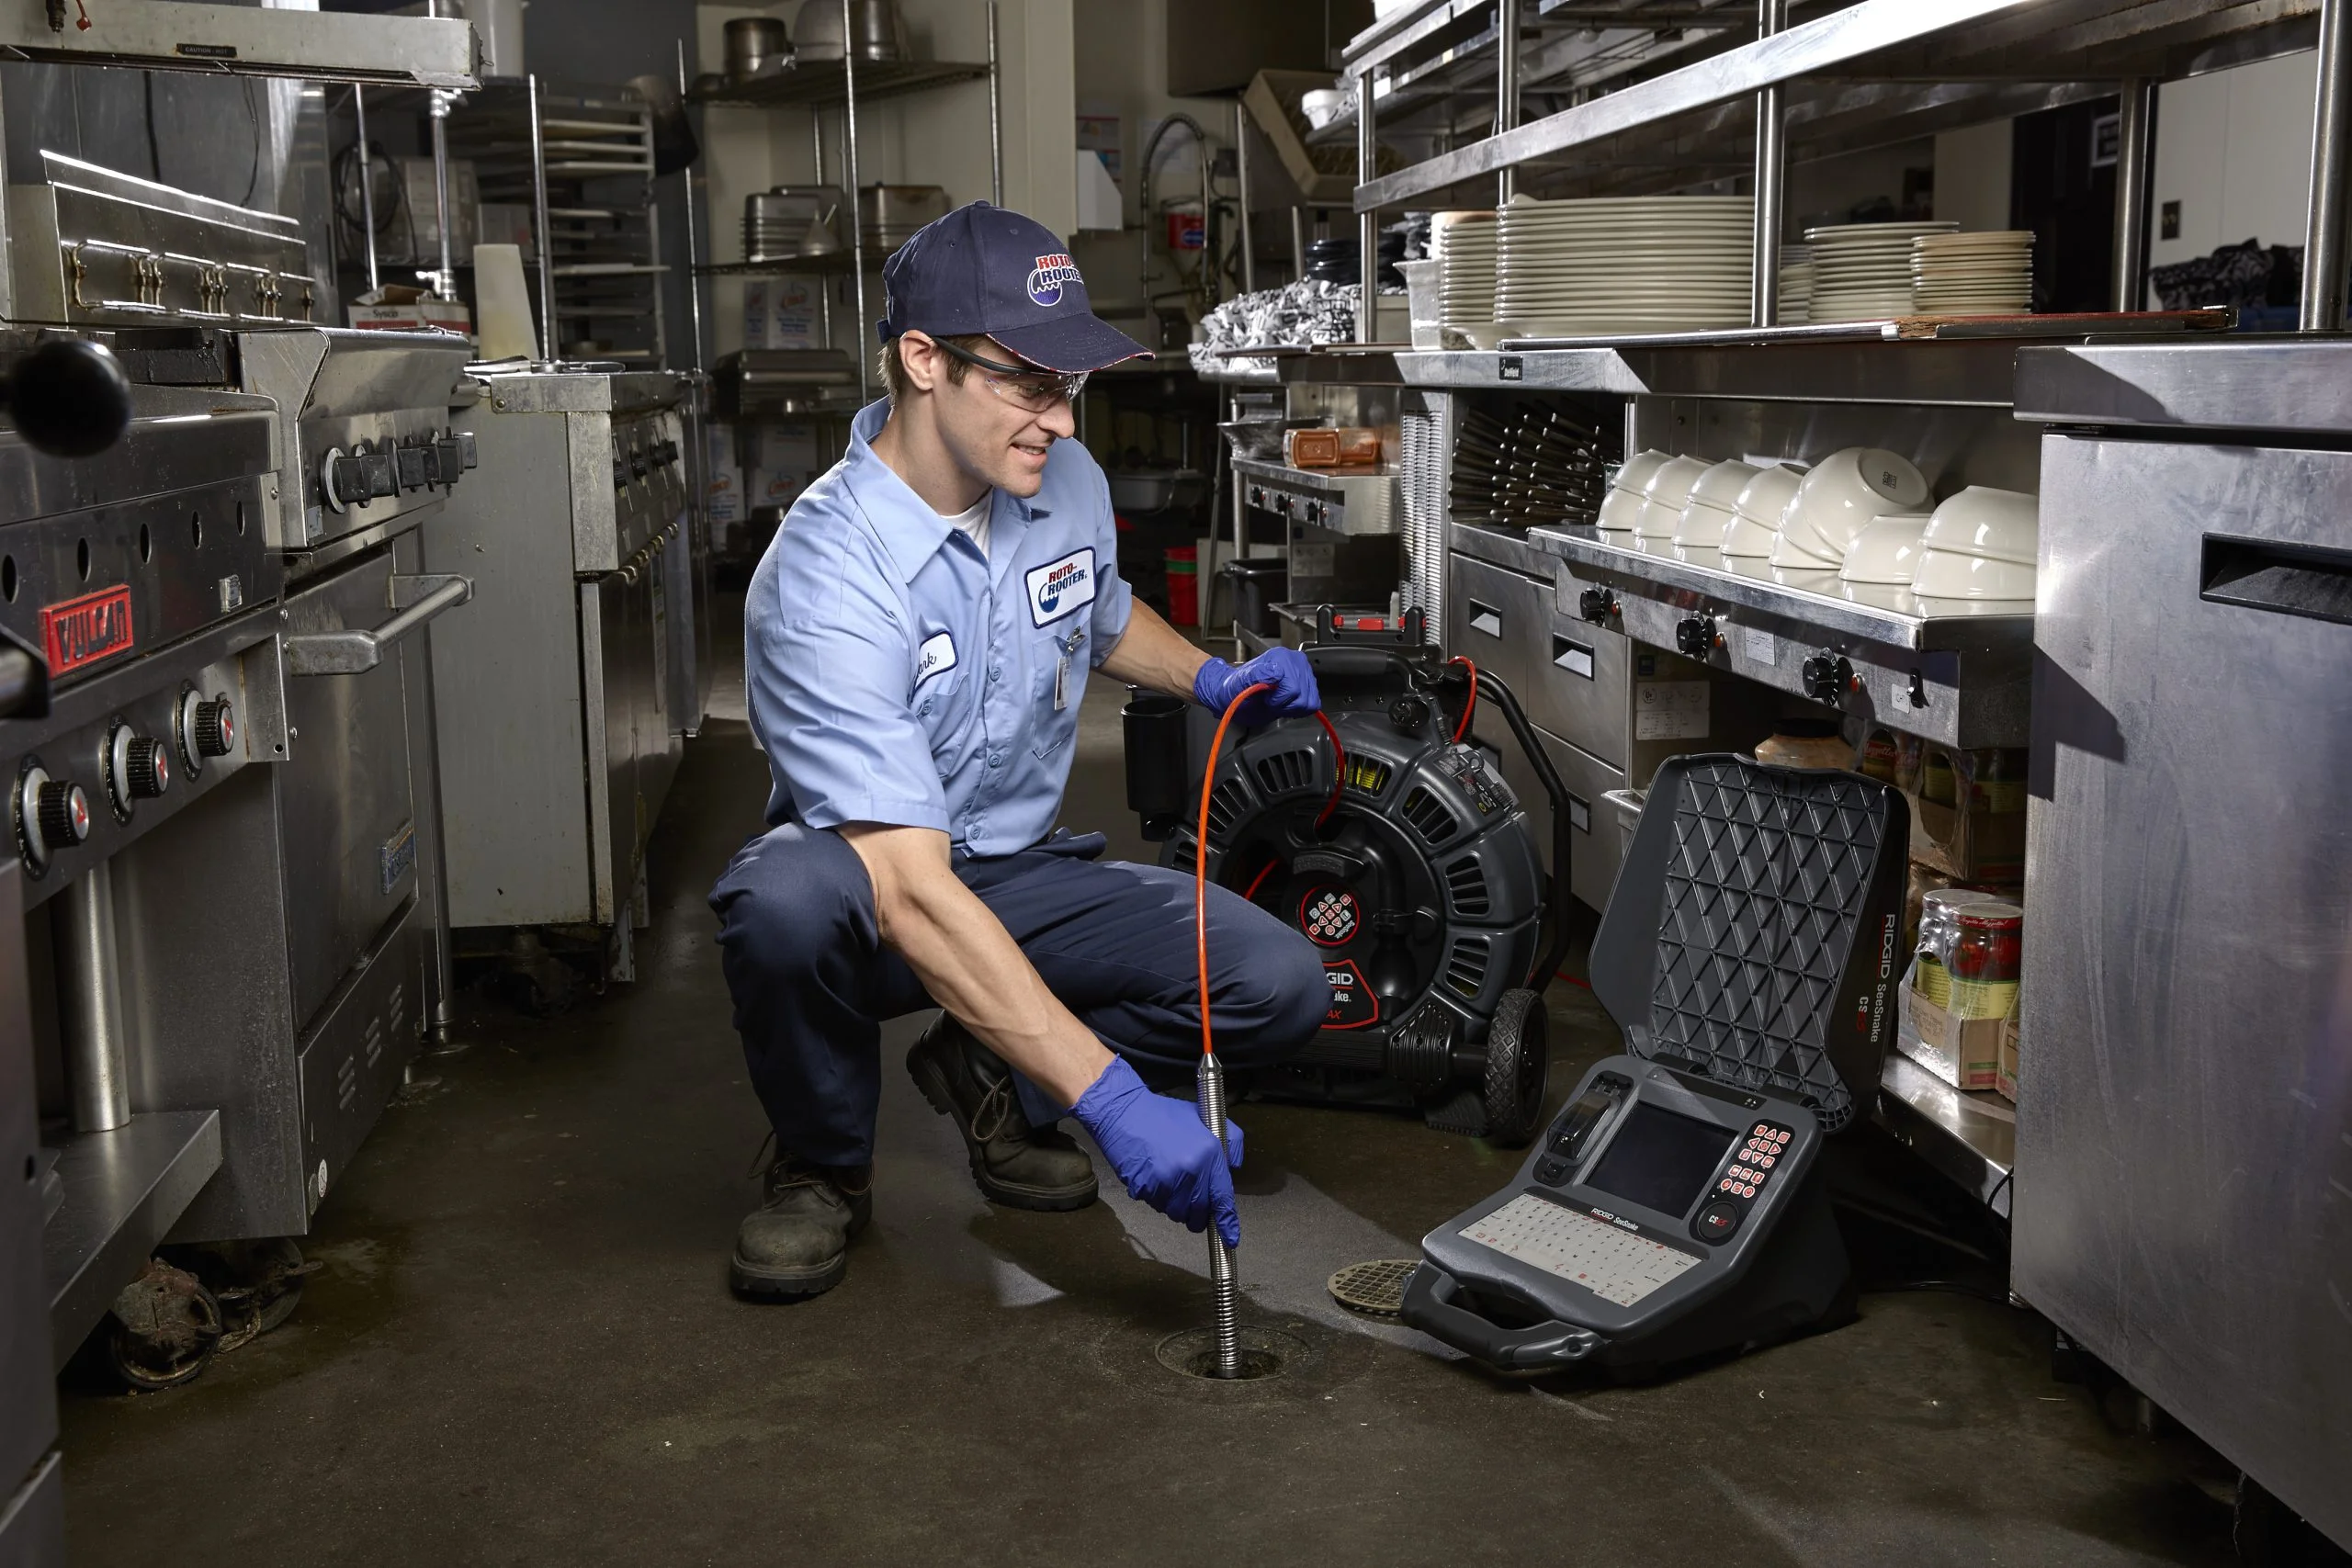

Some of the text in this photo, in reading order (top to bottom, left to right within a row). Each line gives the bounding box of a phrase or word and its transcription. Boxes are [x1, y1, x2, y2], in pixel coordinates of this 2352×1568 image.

[1039, 266, 1084, 286] ROOTE
[1047, 569, 1085, 596] ROOTER
[1048, 562, 1078, 584] ROTO-
[55, 600, 128, 665] VULCAN
[918, 652, 937, 675] ark
[1326, 972, 1353, 985] GID
[1870, 913, 1896, 1043] RIDGID SeeSnake
[1327, 1010, 1342, 1020] AX
[1590, 1207, 1639, 1231] RIDGID SeeSnake
